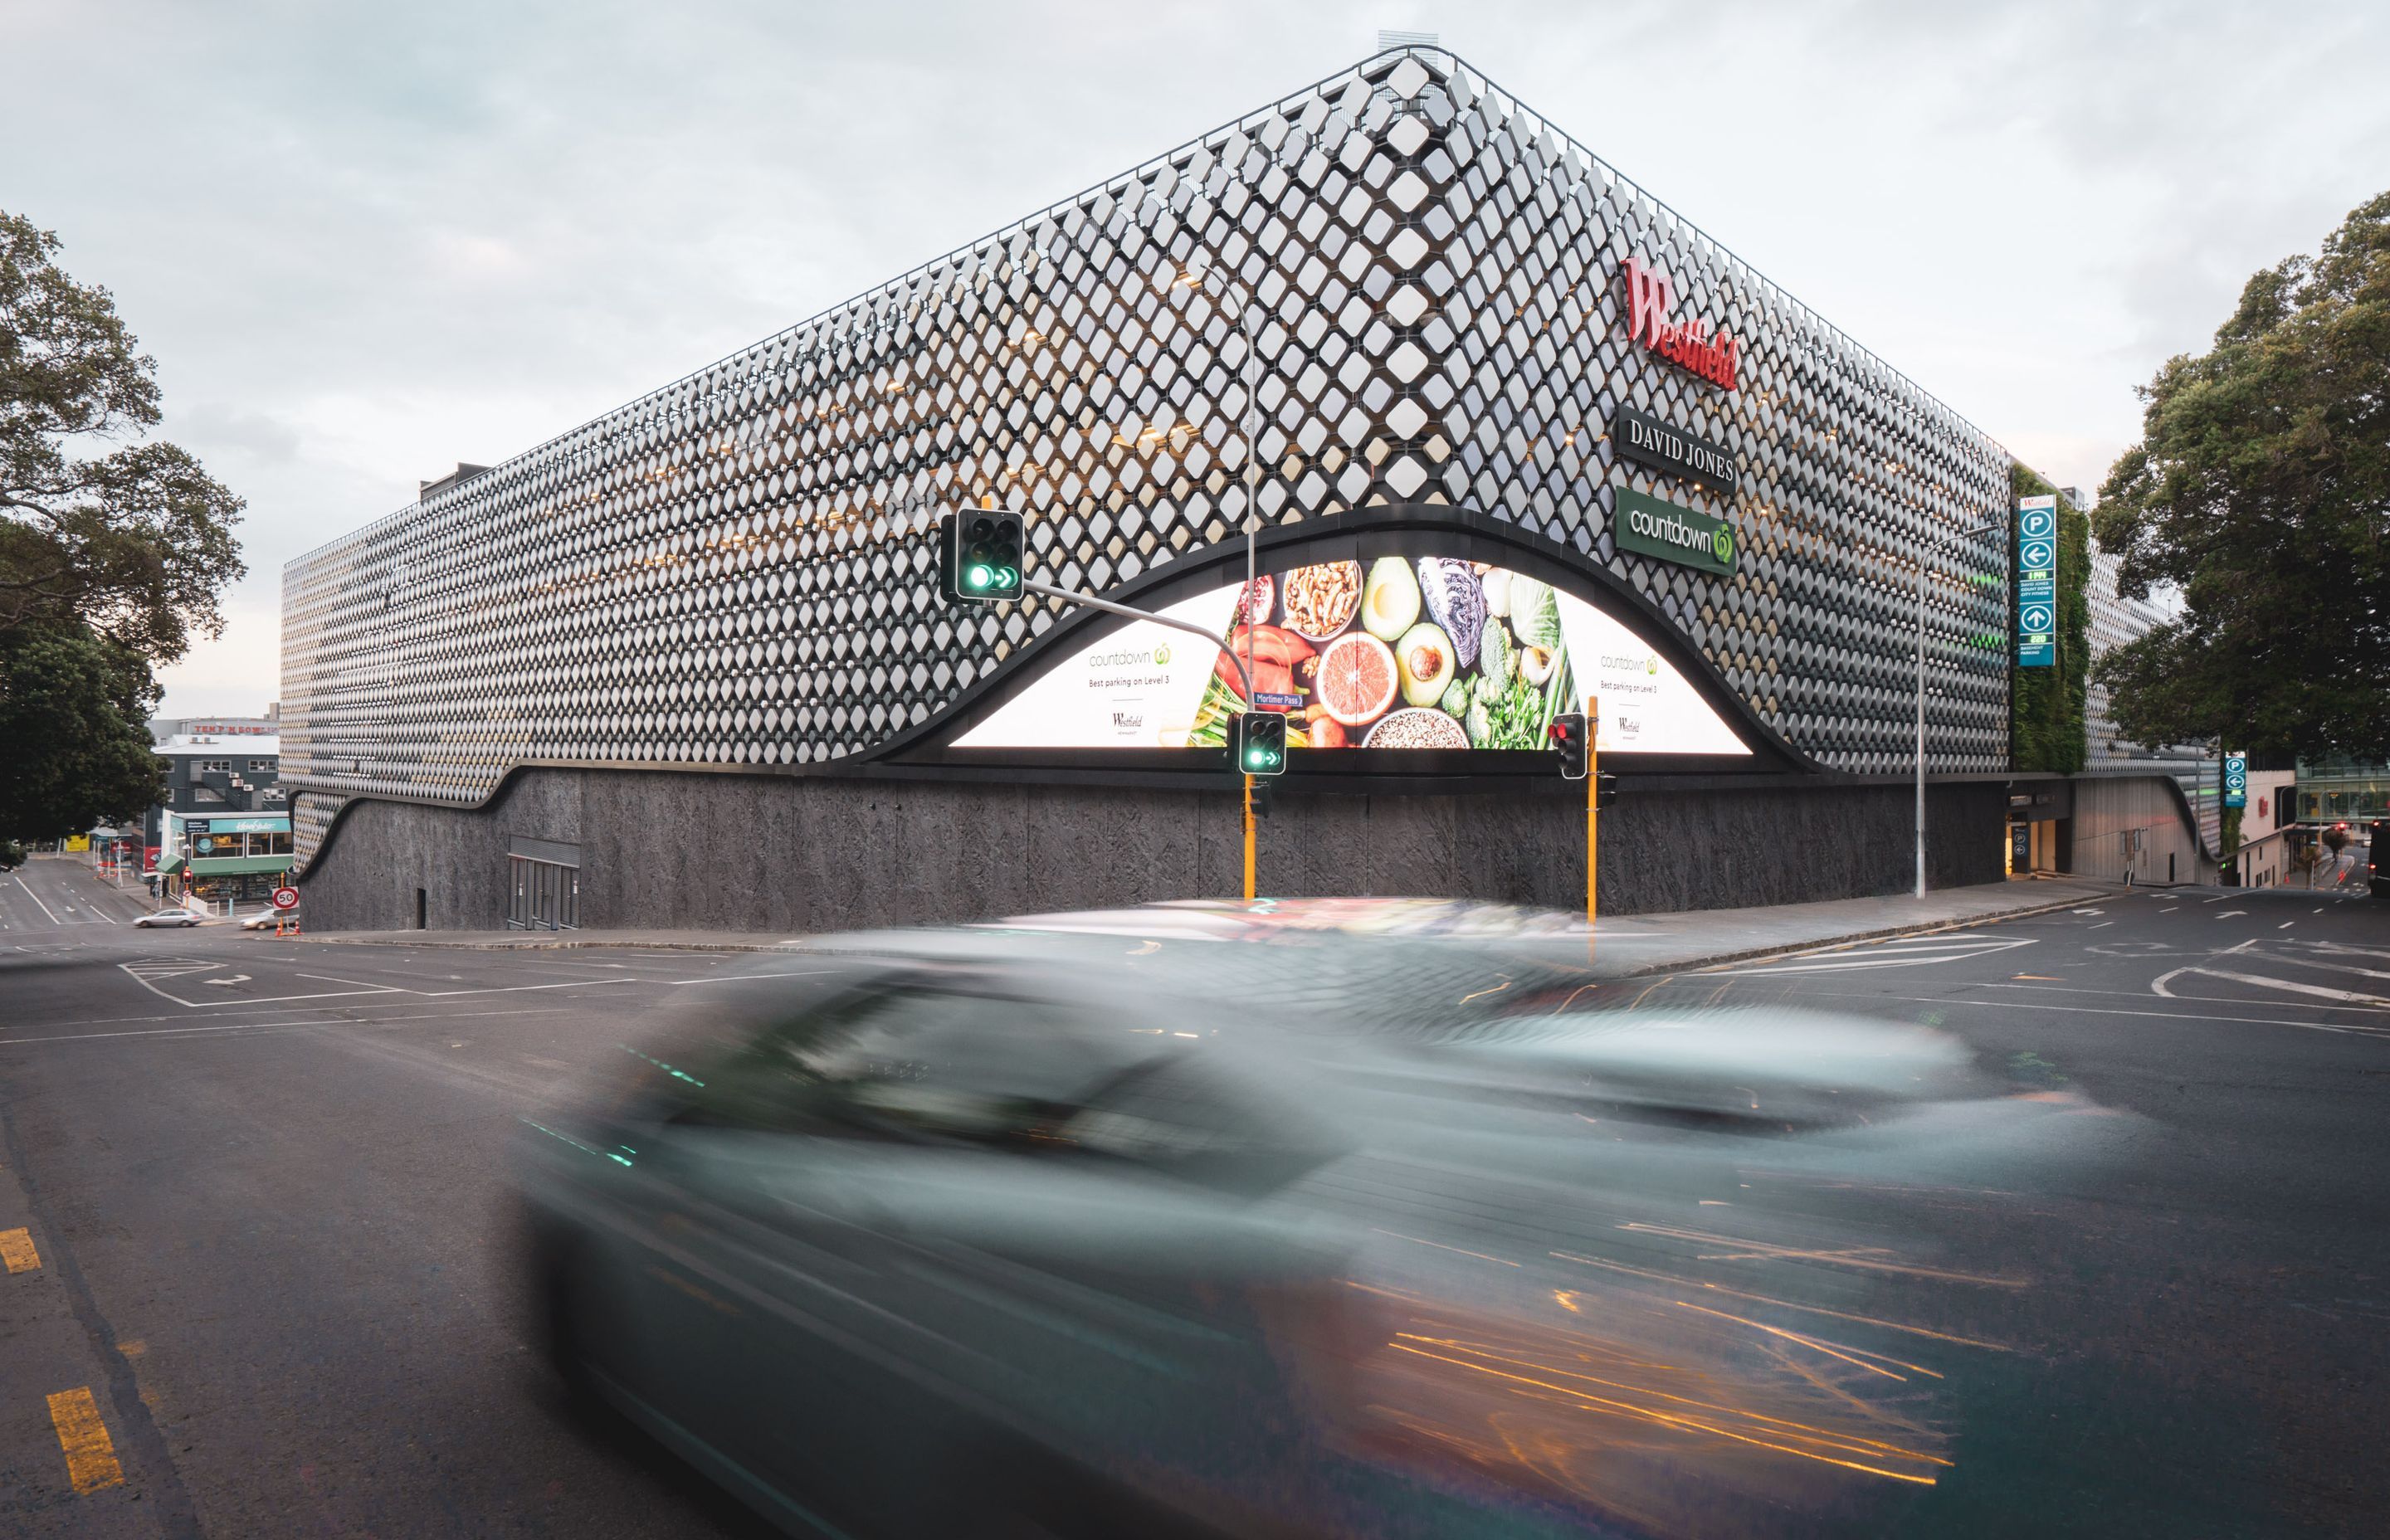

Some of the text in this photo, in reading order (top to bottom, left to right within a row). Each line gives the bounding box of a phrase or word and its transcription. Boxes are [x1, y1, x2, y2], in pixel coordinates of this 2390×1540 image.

[1620, 256, 1740, 392] Westfield
[1631, 418, 1734, 482] DAVID JONES
[1631, 509, 1711, 553] countdown
[2031, 516, 2043, 532] P
[2031, 635, 2046, 643] 220
[1089, 648, 1151, 667] countdown
[1600, 655, 1646, 671] countdown
[1089, 680, 1104, 688] Best
[1105, 677, 1131, 689] parking
[1144, 675, 1163, 685] Level
[1165, 675, 1169, 684] 3
[1600, 680, 1612, 690] Best
[1613, 681, 1632, 694] parking
[1641, 685, 1653, 694] Level
[1256, 694, 1298, 704] Mortimer Pass
[1113, 712, 1143, 728] Westfield
[217, 725, 237, 734] PN
[279, 894, 293, 903] 50
